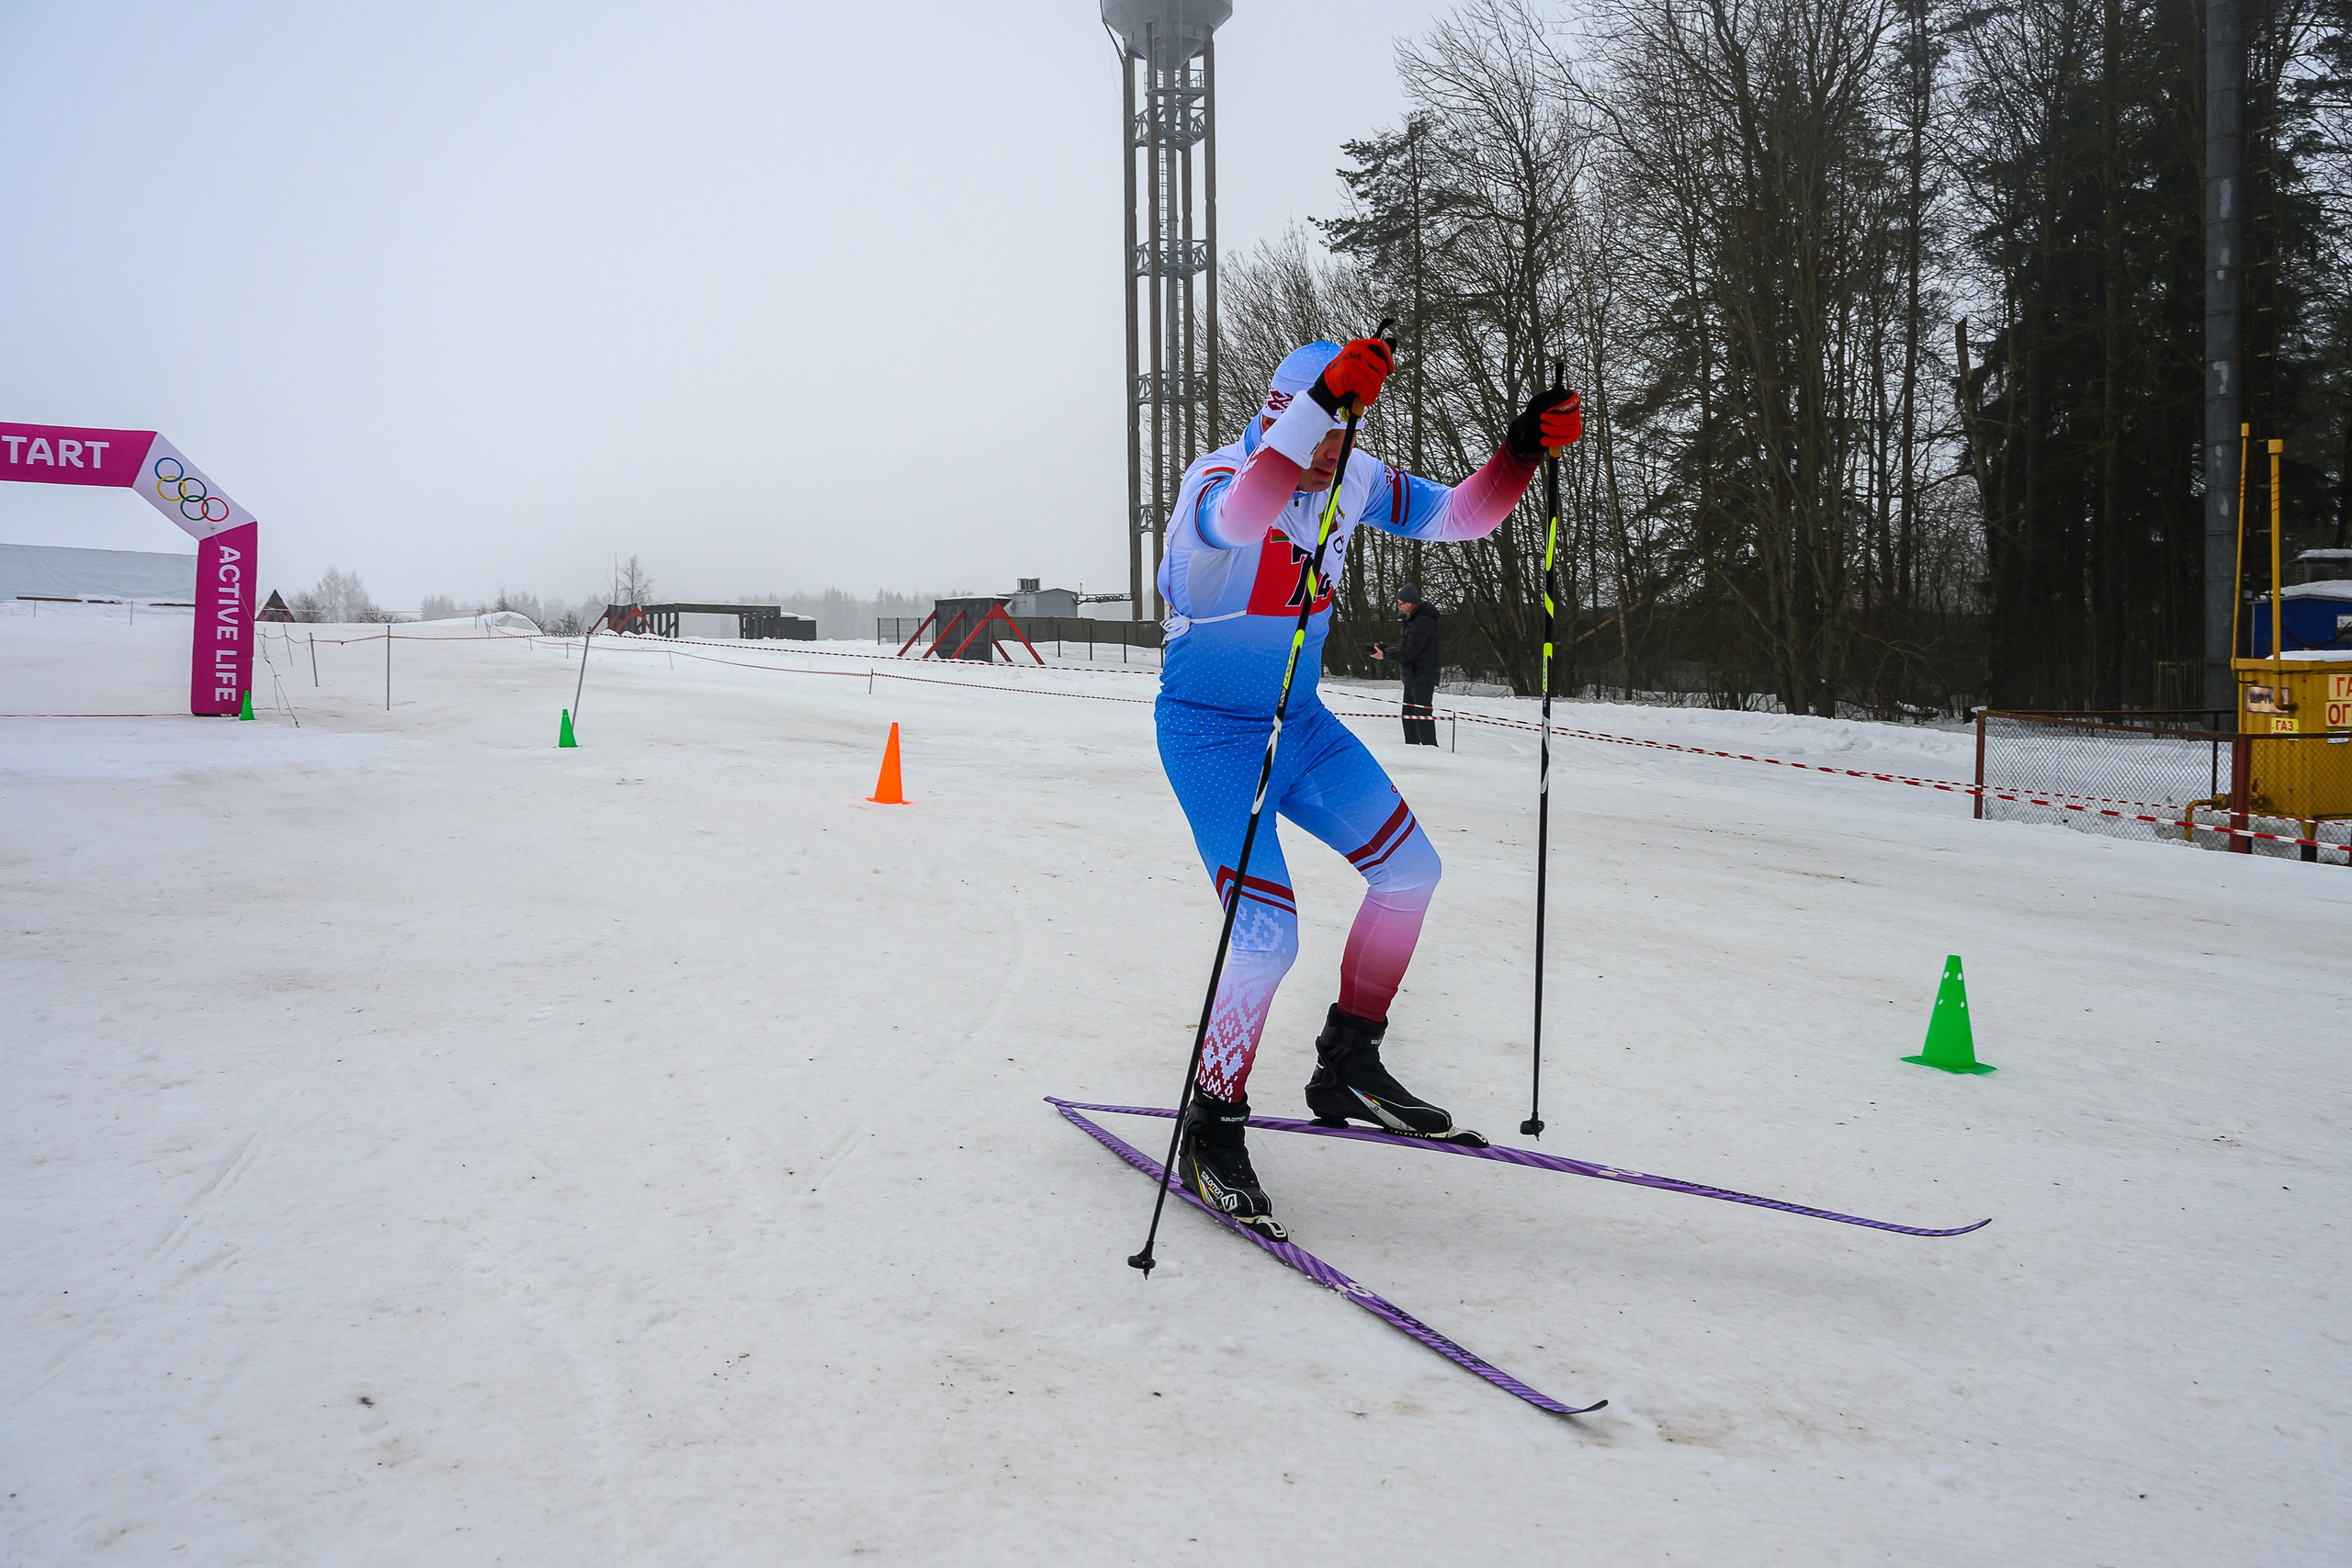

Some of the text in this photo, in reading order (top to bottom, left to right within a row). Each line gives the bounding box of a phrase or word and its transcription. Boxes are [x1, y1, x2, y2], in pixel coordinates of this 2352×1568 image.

[215, 545, 241, 702] ACTIVE LIFE
[2275, 719, 2294, 731] ГАЗ
[1200, 1170, 1224, 1200] SALOMON
